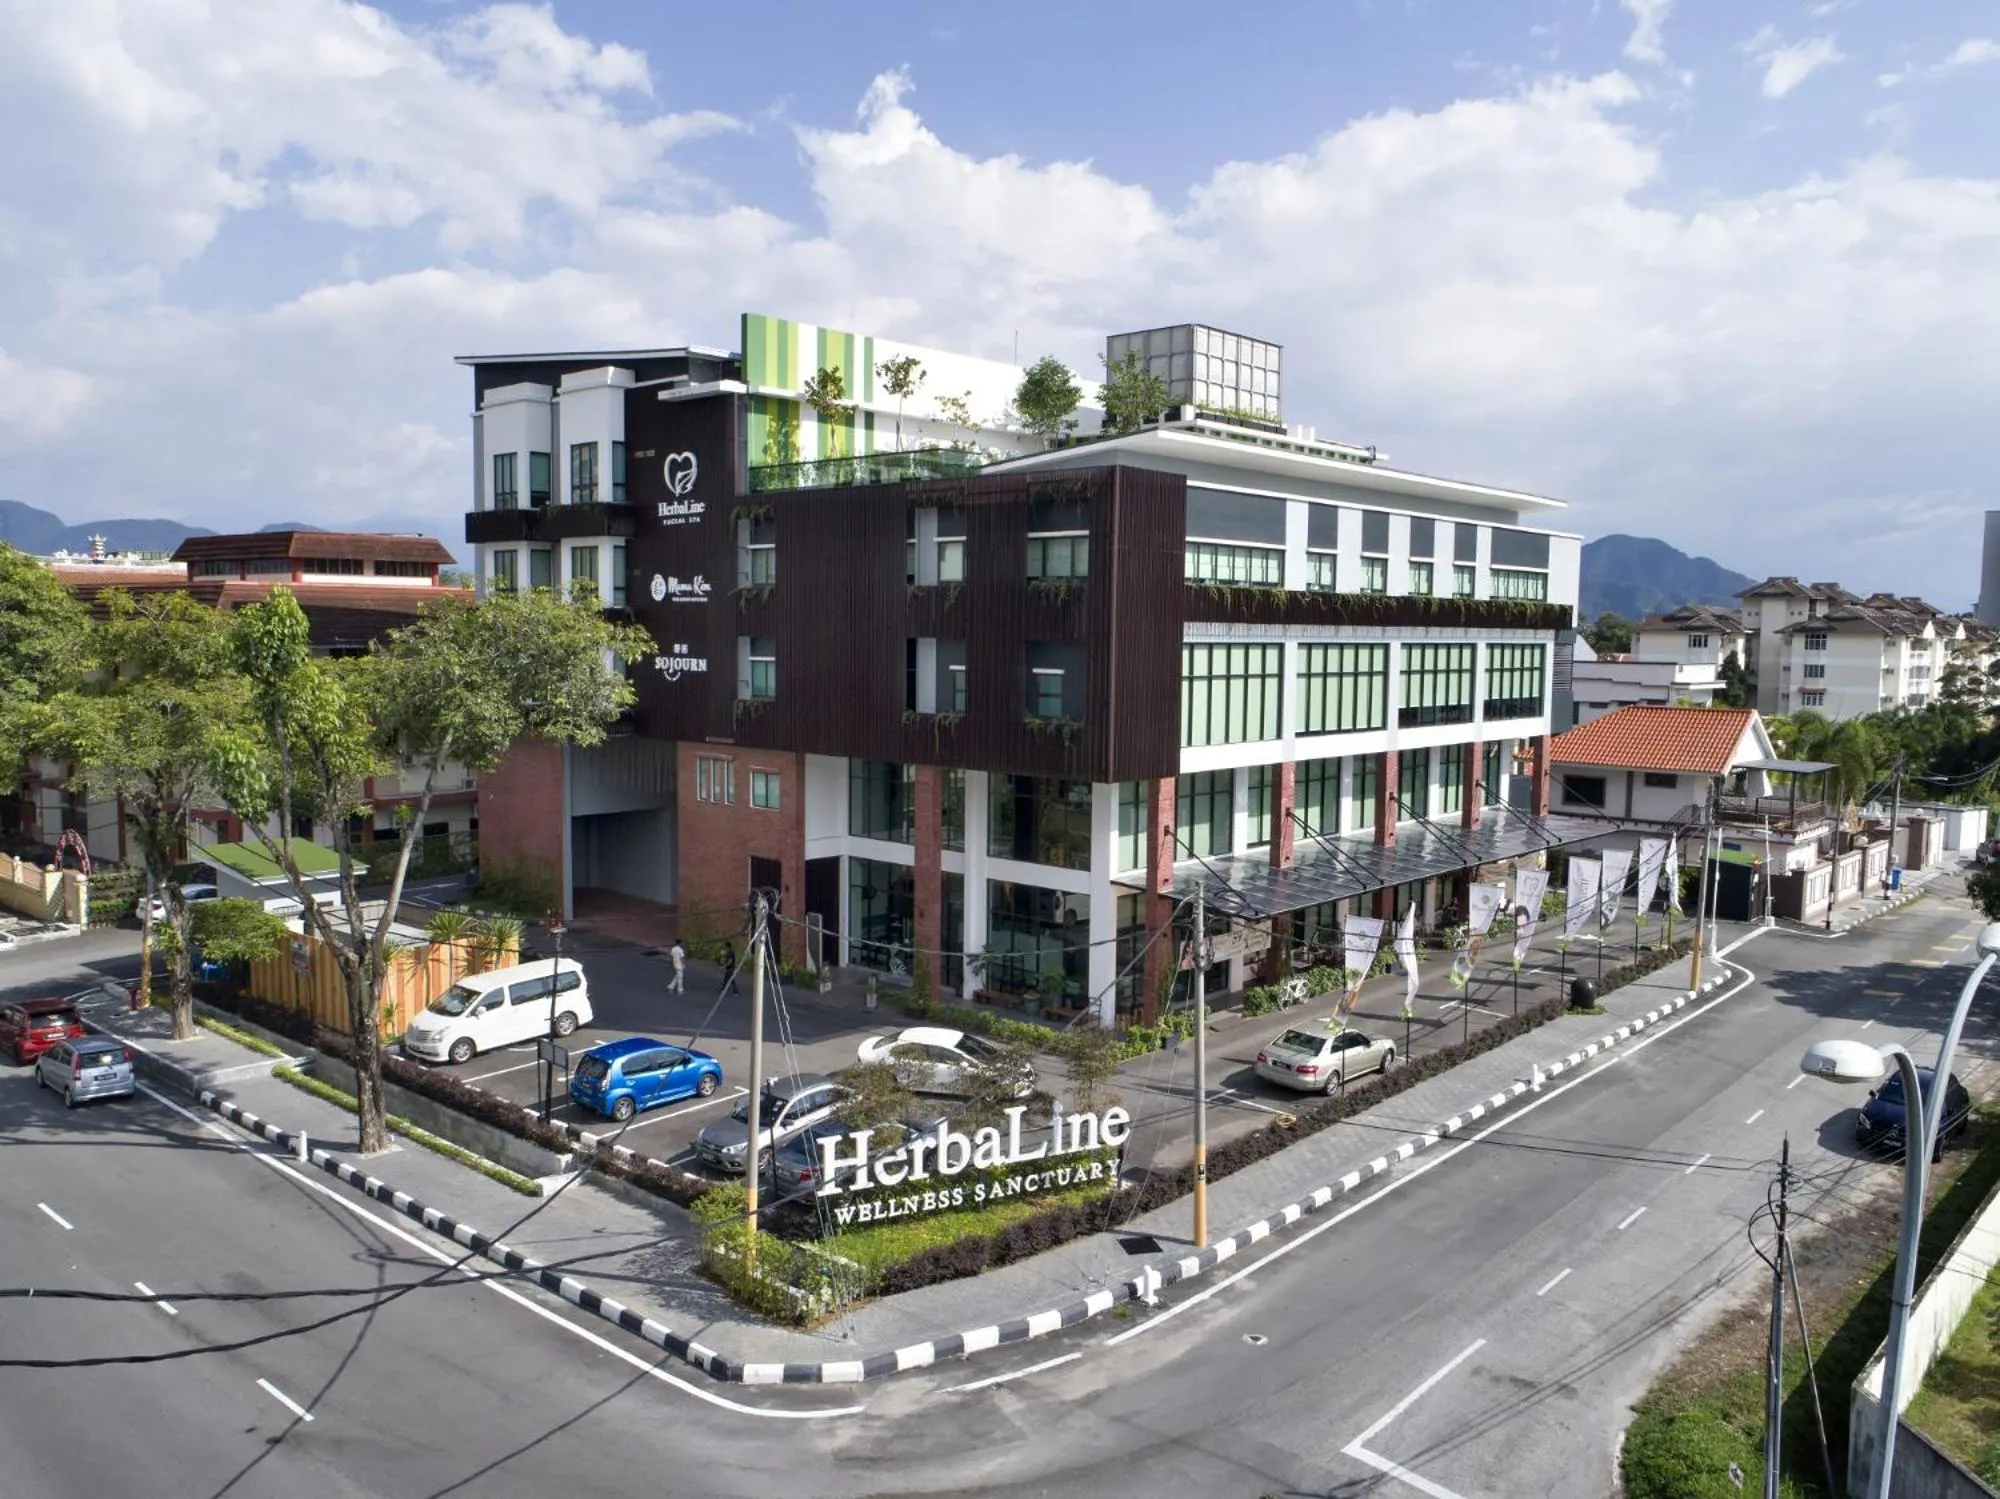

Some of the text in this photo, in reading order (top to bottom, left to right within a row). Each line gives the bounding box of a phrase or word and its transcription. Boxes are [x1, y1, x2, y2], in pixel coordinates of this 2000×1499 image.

[658, 500, 706, 517] HerbaLine
[655, 657, 708, 673] SOJOURN
[816, 1100, 1132, 1197] HerbaLine
[834, 1158, 1122, 1226] WELLNESS SANCTUARY
